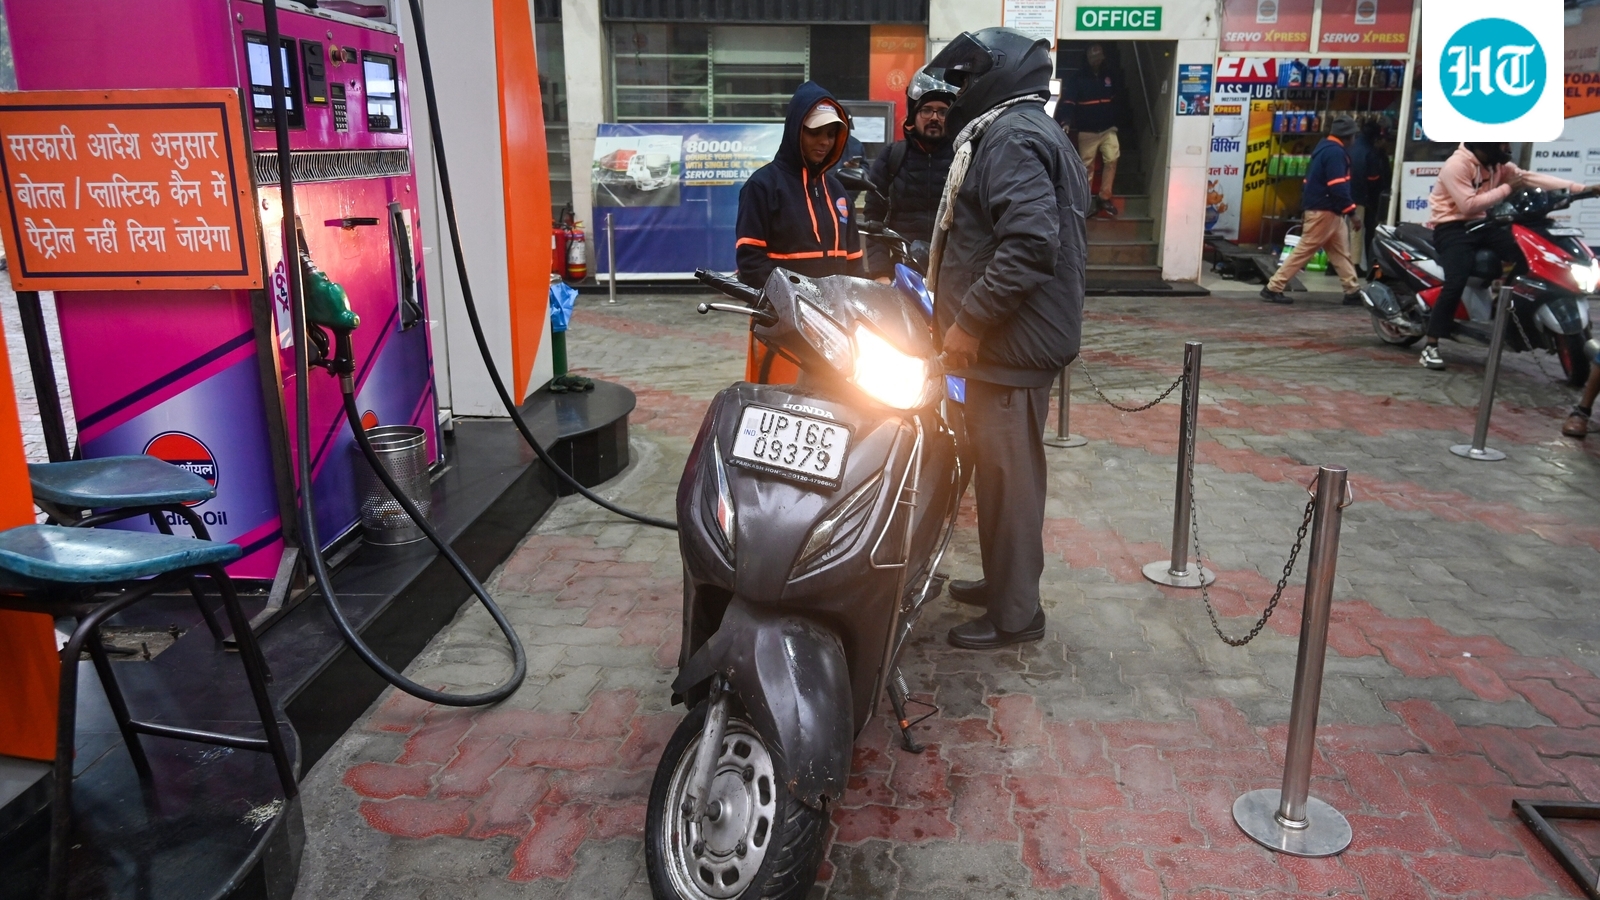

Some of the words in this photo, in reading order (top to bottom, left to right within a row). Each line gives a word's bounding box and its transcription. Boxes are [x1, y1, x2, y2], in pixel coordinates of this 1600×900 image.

[1082, 10, 1156, 27] OFFICE
[1224, 32, 1262, 42] SERVO
[1265, 29, 1307, 42] XPRESS
[1322, 33, 1360, 43] SERVO
[1363, 31, 1405, 43] XPRESS
[7, 124, 77, 161] सरकारी
[87, 123, 141, 160] आदेश
[151, 132, 219, 170] अनुसार
[686, 140, 742, 153] 80000
[1246, 140, 1270, 153] EEPS
[714, 153, 733, 161] YOUR
[1535, 150, 1549, 159] RO
[1551, 150, 1580, 159] NAME
[685, 161, 704, 170] WITH
[704, 161, 729, 169] SINGLE
[685, 170, 714, 179] SERVO
[716, 170, 738, 178] PRIDE
[14, 173, 66, 209] बोतल
[86, 173, 160, 208] प्लास्टिक
[168, 169, 202, 207] कैन
[211, 170, 227, 207] में
[24, 217, 76, 259] पैट्रोल
[83, 218, 118, 254] नहीं
[127, 218, 166, 253] दिया
[175, 216, 231, 252] जायेगा
[783, 403, 835, 420] HONDA
[743, 428, 756, 437] IND
